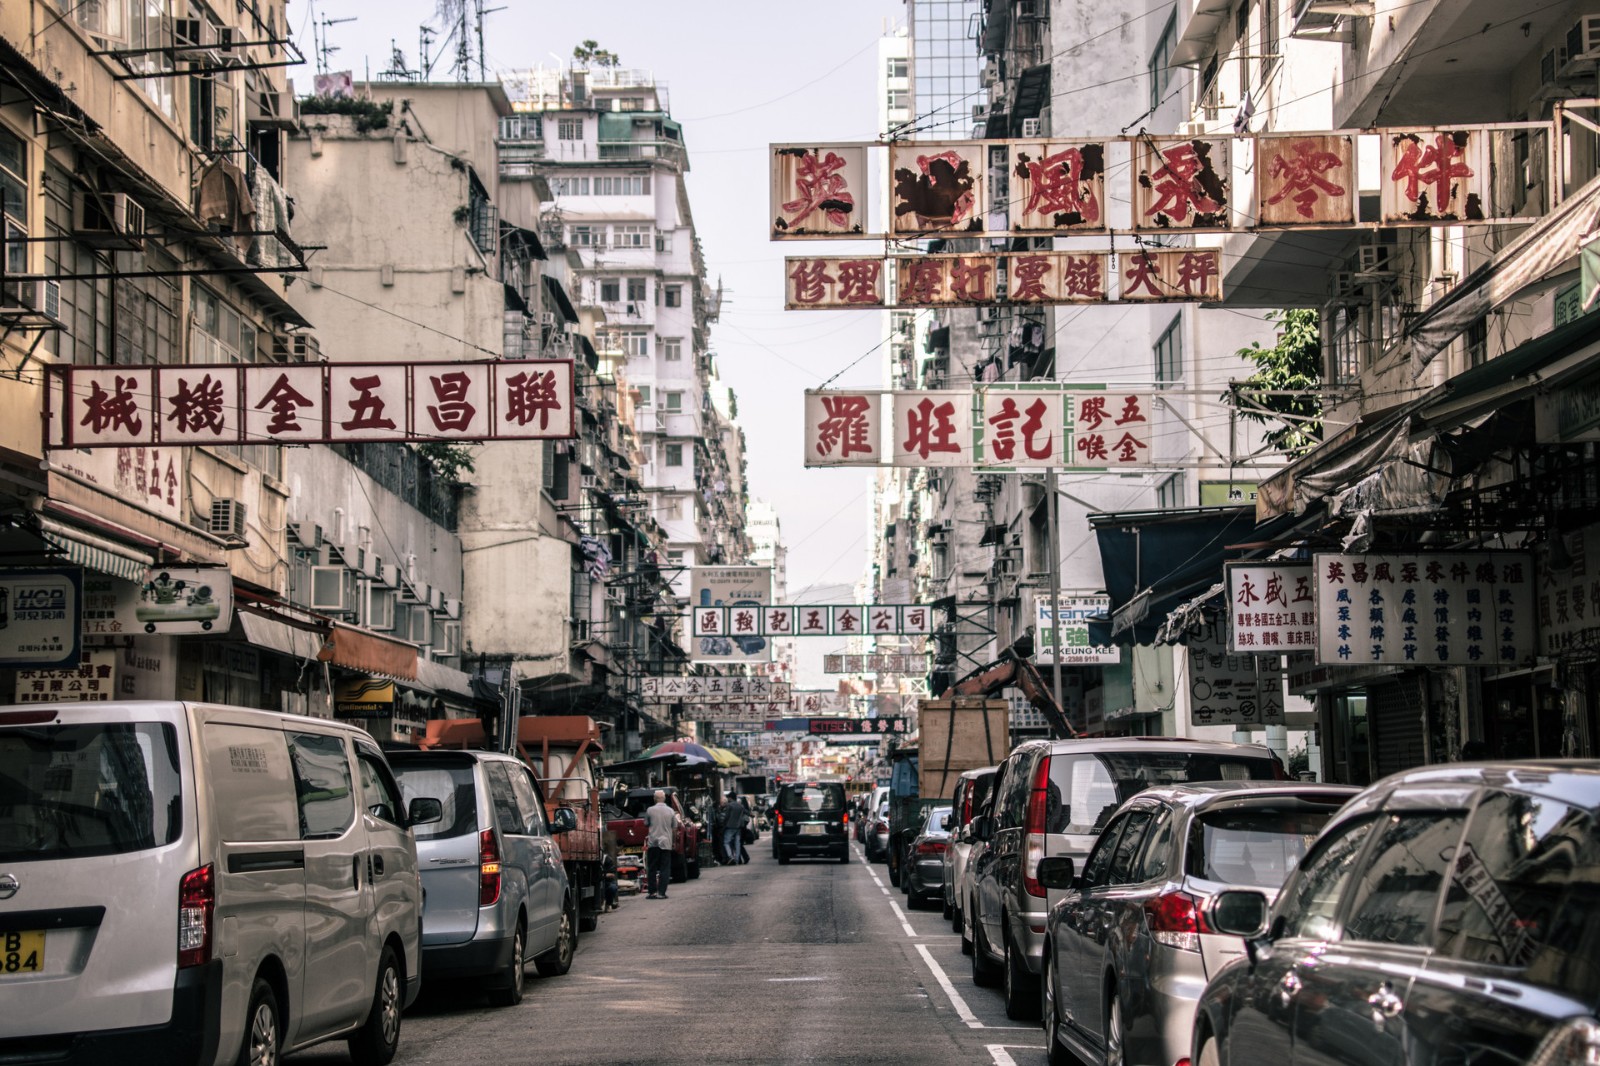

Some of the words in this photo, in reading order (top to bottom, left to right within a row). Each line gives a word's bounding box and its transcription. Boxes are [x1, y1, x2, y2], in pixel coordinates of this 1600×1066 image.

[783, 135, 1474, 226] 英風泵零件
[815, 395, 1053, 460] 羅旺記
[17, 589, 65, 608] HCP
[1336, 588, 1352, 661] 風泵零件
[1368, 588, 1385, 661] 各類牌子
[31, 680, 100, 692] 有限公司
